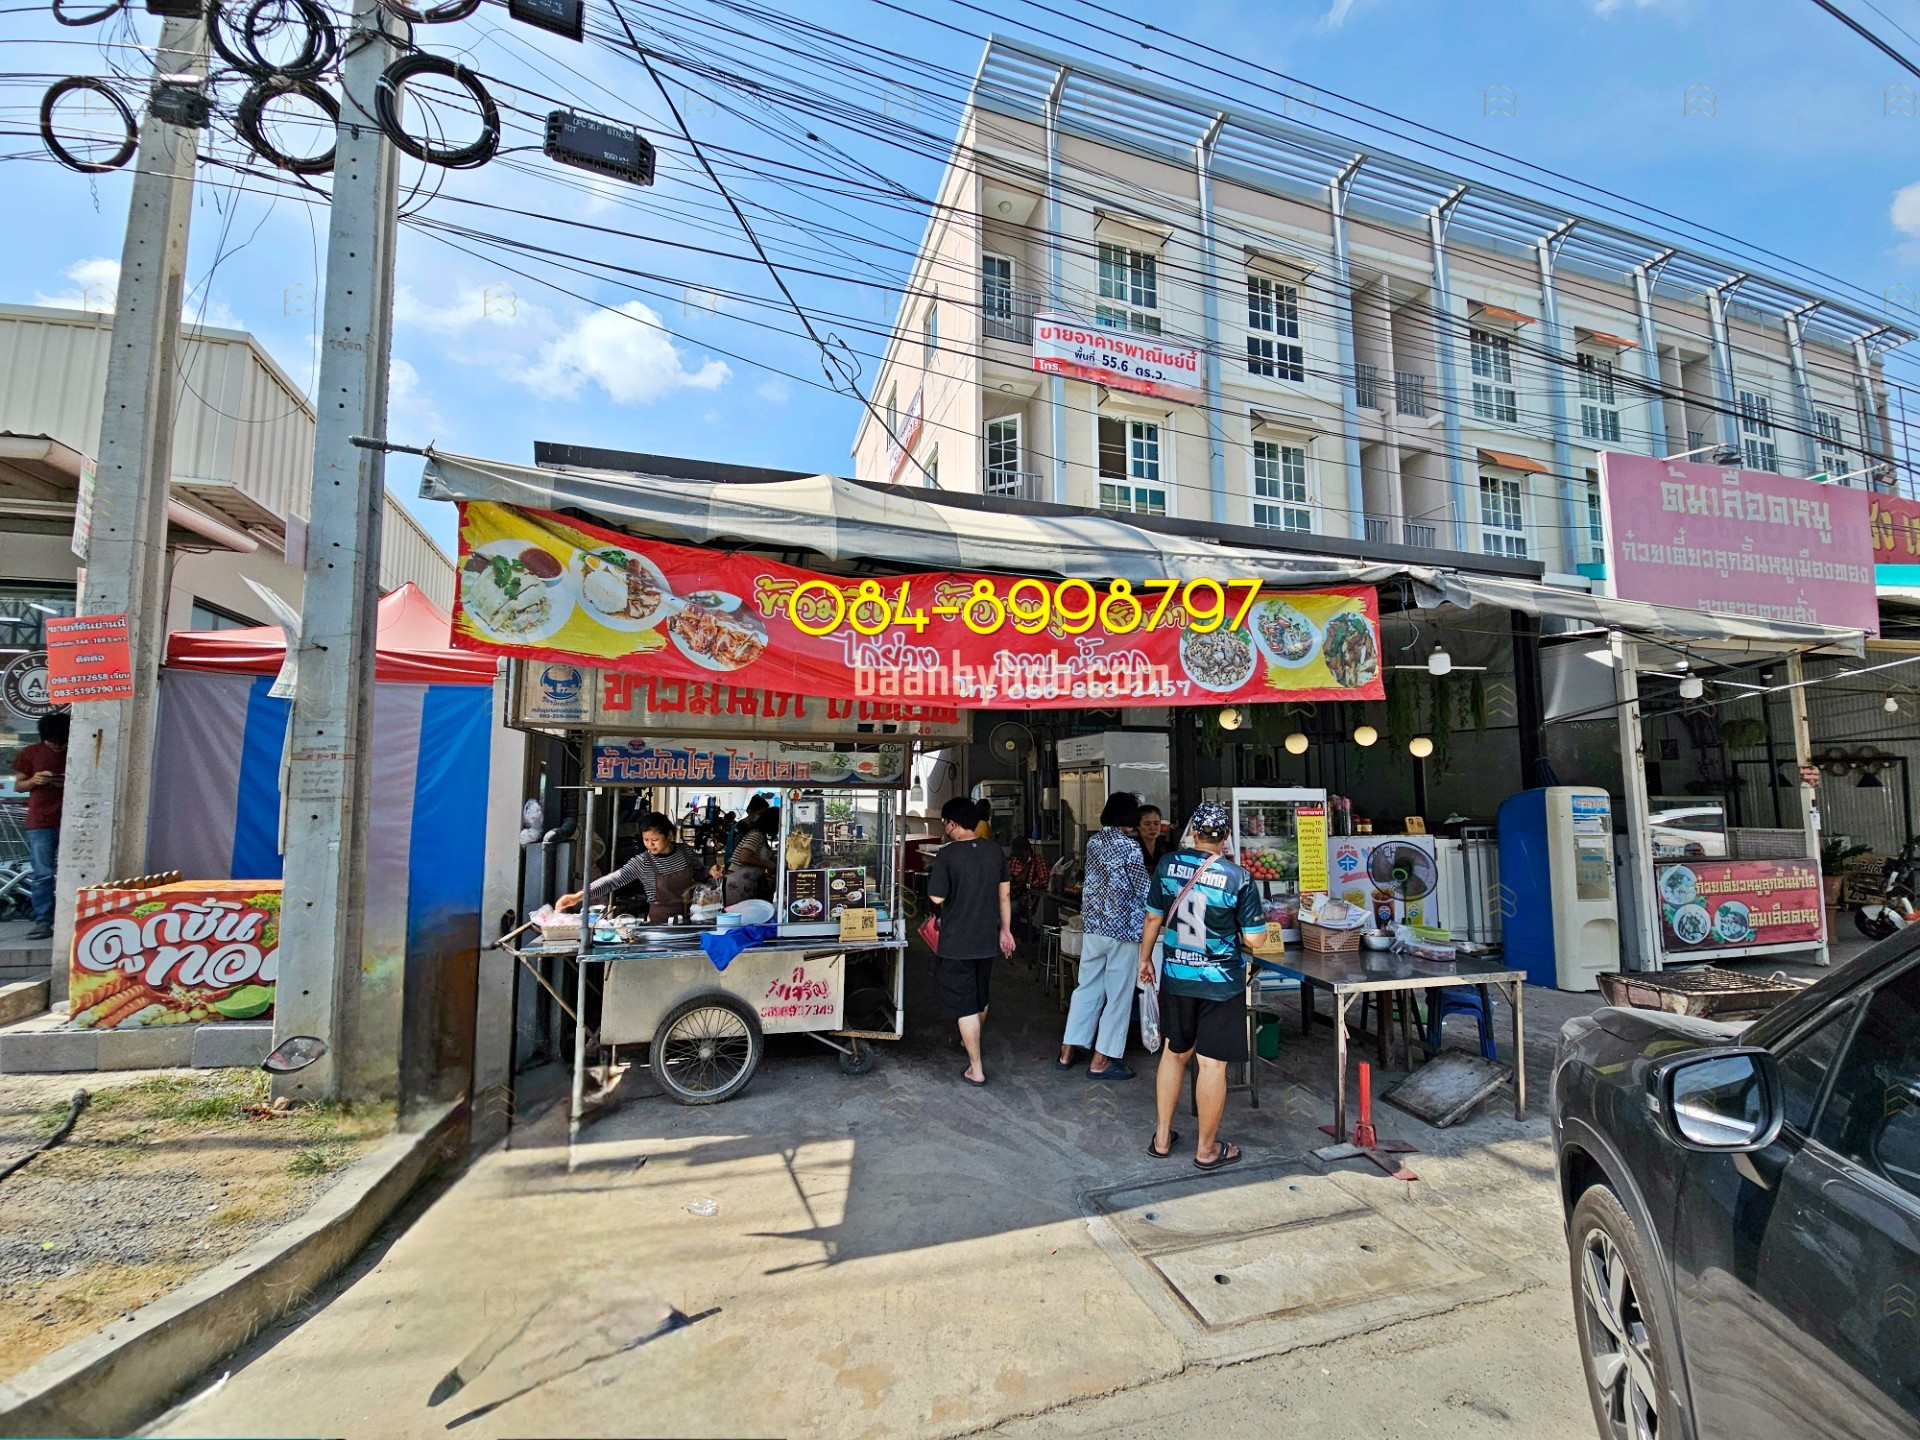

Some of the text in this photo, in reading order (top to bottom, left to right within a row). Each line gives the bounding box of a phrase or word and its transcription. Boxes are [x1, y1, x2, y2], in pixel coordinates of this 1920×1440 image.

[1039, 325, 1198, 373] ขายอาคารพาณิชย์นี้
[1101, 353, 1129, 373] 55.6
[1660, 465, 1833, 544] ต้มเลือดหมู
[597, 747, 715, 780] ข้าวมันไก่
[77, 897, 263, 974] ลูกชิ้น
